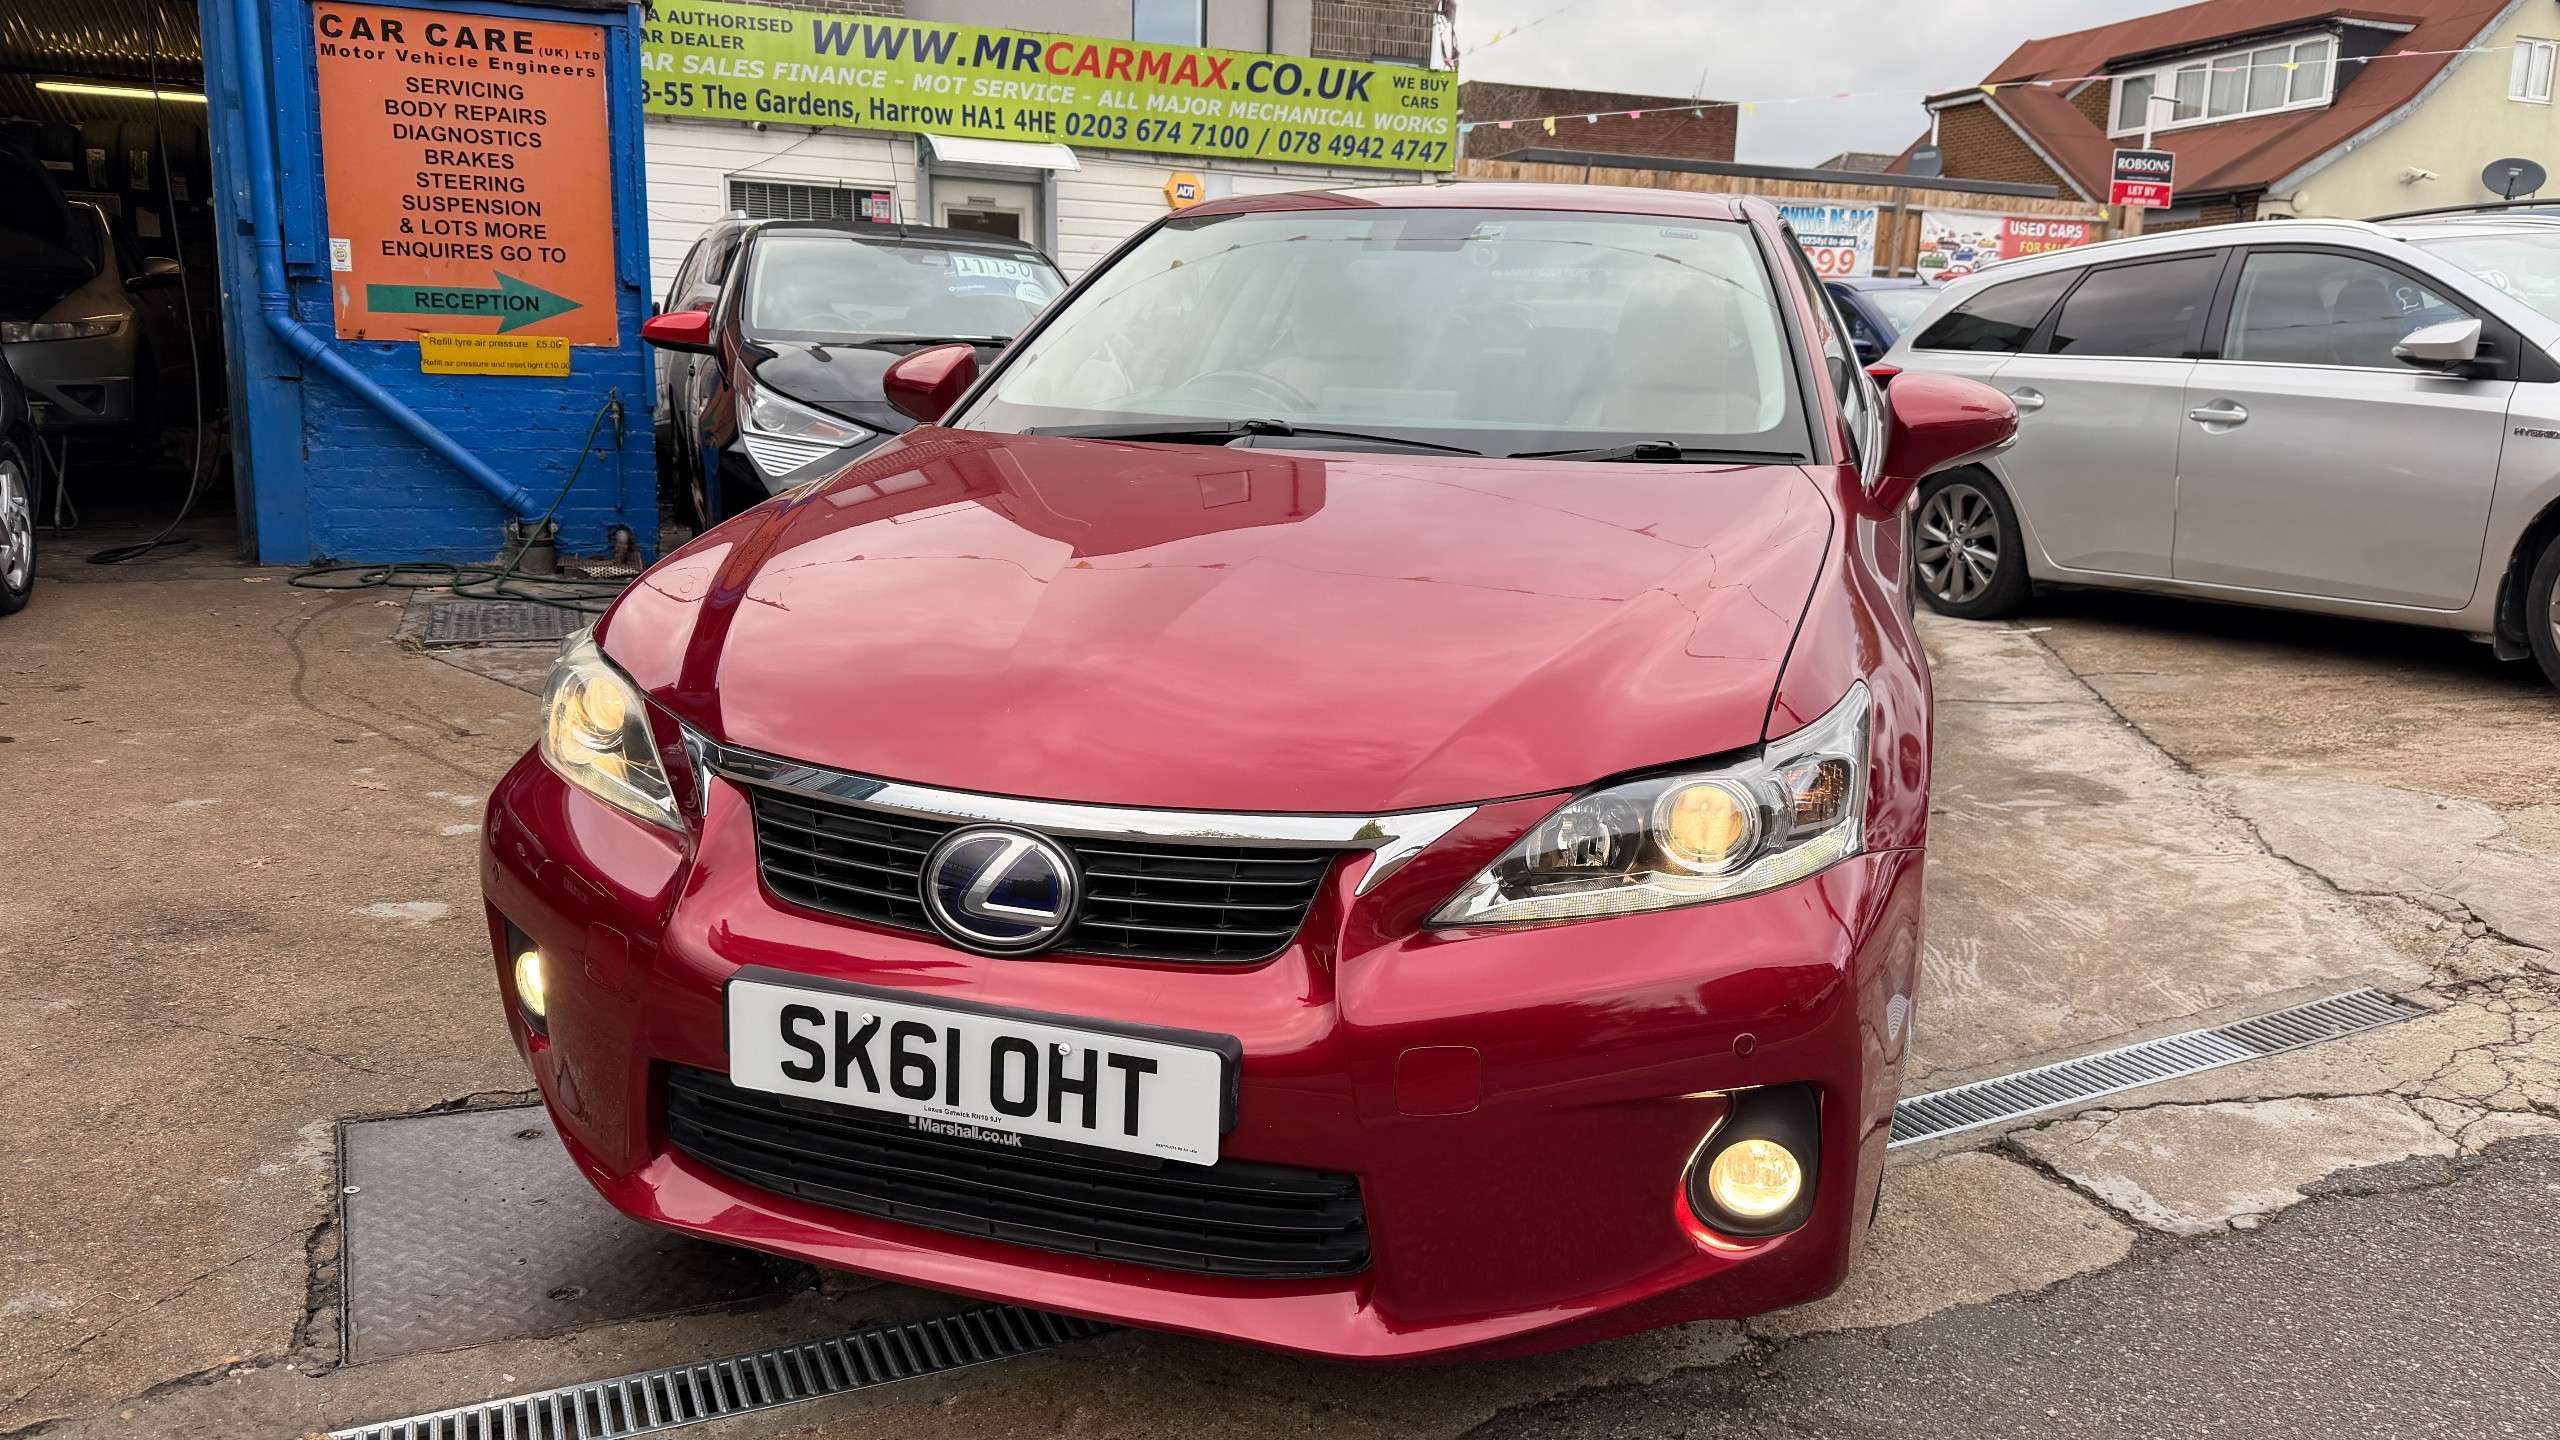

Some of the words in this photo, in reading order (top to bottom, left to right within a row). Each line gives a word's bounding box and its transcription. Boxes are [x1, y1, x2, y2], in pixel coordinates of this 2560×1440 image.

[667, 10, 793, 33] AUTHORISED
[319, 14, 404, 43] CAR
[425, 23, 534, 54] CARE
[539, 47, 569, 59] (UK)
[575, 50, 601, 61] LTD
[670, 30, 744, 50] DEALER
[320, 43, 385, 60] Motor
[396, 49, 478, 68] Vehicle
[489, 57, 596, 78] Engineers
[812, 18, 1375, 103] WWW.MRCARMAX.CO.UK
[406, 76, 524, 101] SERVICING
[1393, 75, 1417, 90] WE
[1420, 78, 1449, 92] BUY
[682, 54, 772, 79] SALES
[774, 63, 887, 89] FINANCE
[912, 74, 968, 95] MOT
[972, 79, 1075, 105] SERVICE
[1098, 88, 1142, 110] ALL
[1147, 95, 1221, 116] MAJOR
[1229, 102, 1365, 129] MECHANICAL
[1374, 115, 1448, 135] WORKS
[1401, 95, 1439, 110] CARS
[385, 99, 447, 119] BODY
[455, 104, 547, 126] REPAIRS
[702, 84, 747, 112] The
[755, 88, 860, 125] Gardens,
[869, 97, 952, 125] Harrow
[961, 105, 1004, 130] HA1
[1014, 109, 1056, 133] 4HE
[1065, 113, 1127, 139] 0203
[1136, 119, 1180, 144] 674
[1191, 123, 1249, 150] 7100
[1278, 130, 1320, 155] 078
[1328, 134, 1384, 160] 4942
[1391, 139, 1448, 163] 4747
[393, 124, 542, 148] DIAGNOSTICS
[425, 150, 515, 170] BRAKES
[2118, 158, 2170, 172] ROBSONS
[416, 172, 525, 193] STEERING
[1177, 185, 1194, 199] ADT
[2127, 185, 2144, 196] LET
[2144, 186, 2157, 197] BY
[402, 196, 541, 217] SUSPENSION
[400, 218, 414, 234] &
[421, 219, 478, 237] LOTS
[485, 222, 547, 240] MORE
[2010, 220, 2045, 237] USED
[2049, 223, 2083, 239] CARS
[382, 240, 494, 261] ENQUIRES
[501, 245, 531, 263] GO
[539, 247, 567, 264] TO
[2019, 241, 2040, 253] FOR
[415, 291, 540, 312] RECEPTION
[429, 336, 452, 346] Refill
[455, 338, 472, 348] tyre
[475, 339, 486, 347] air
[489, 340, 529, 349] pressure
[423, 358, 443, 367] Refill
[456, 360, 489, 369] pressure
[527, 361, 543, 370] light
[780, 1003, 959, 1107] SK61
[990, 1035, 1158, 1136] OHT
[924, 1105, 943, 1114] Lexus
[919, 1118, 1023, 1147] Marshall.co.uk
